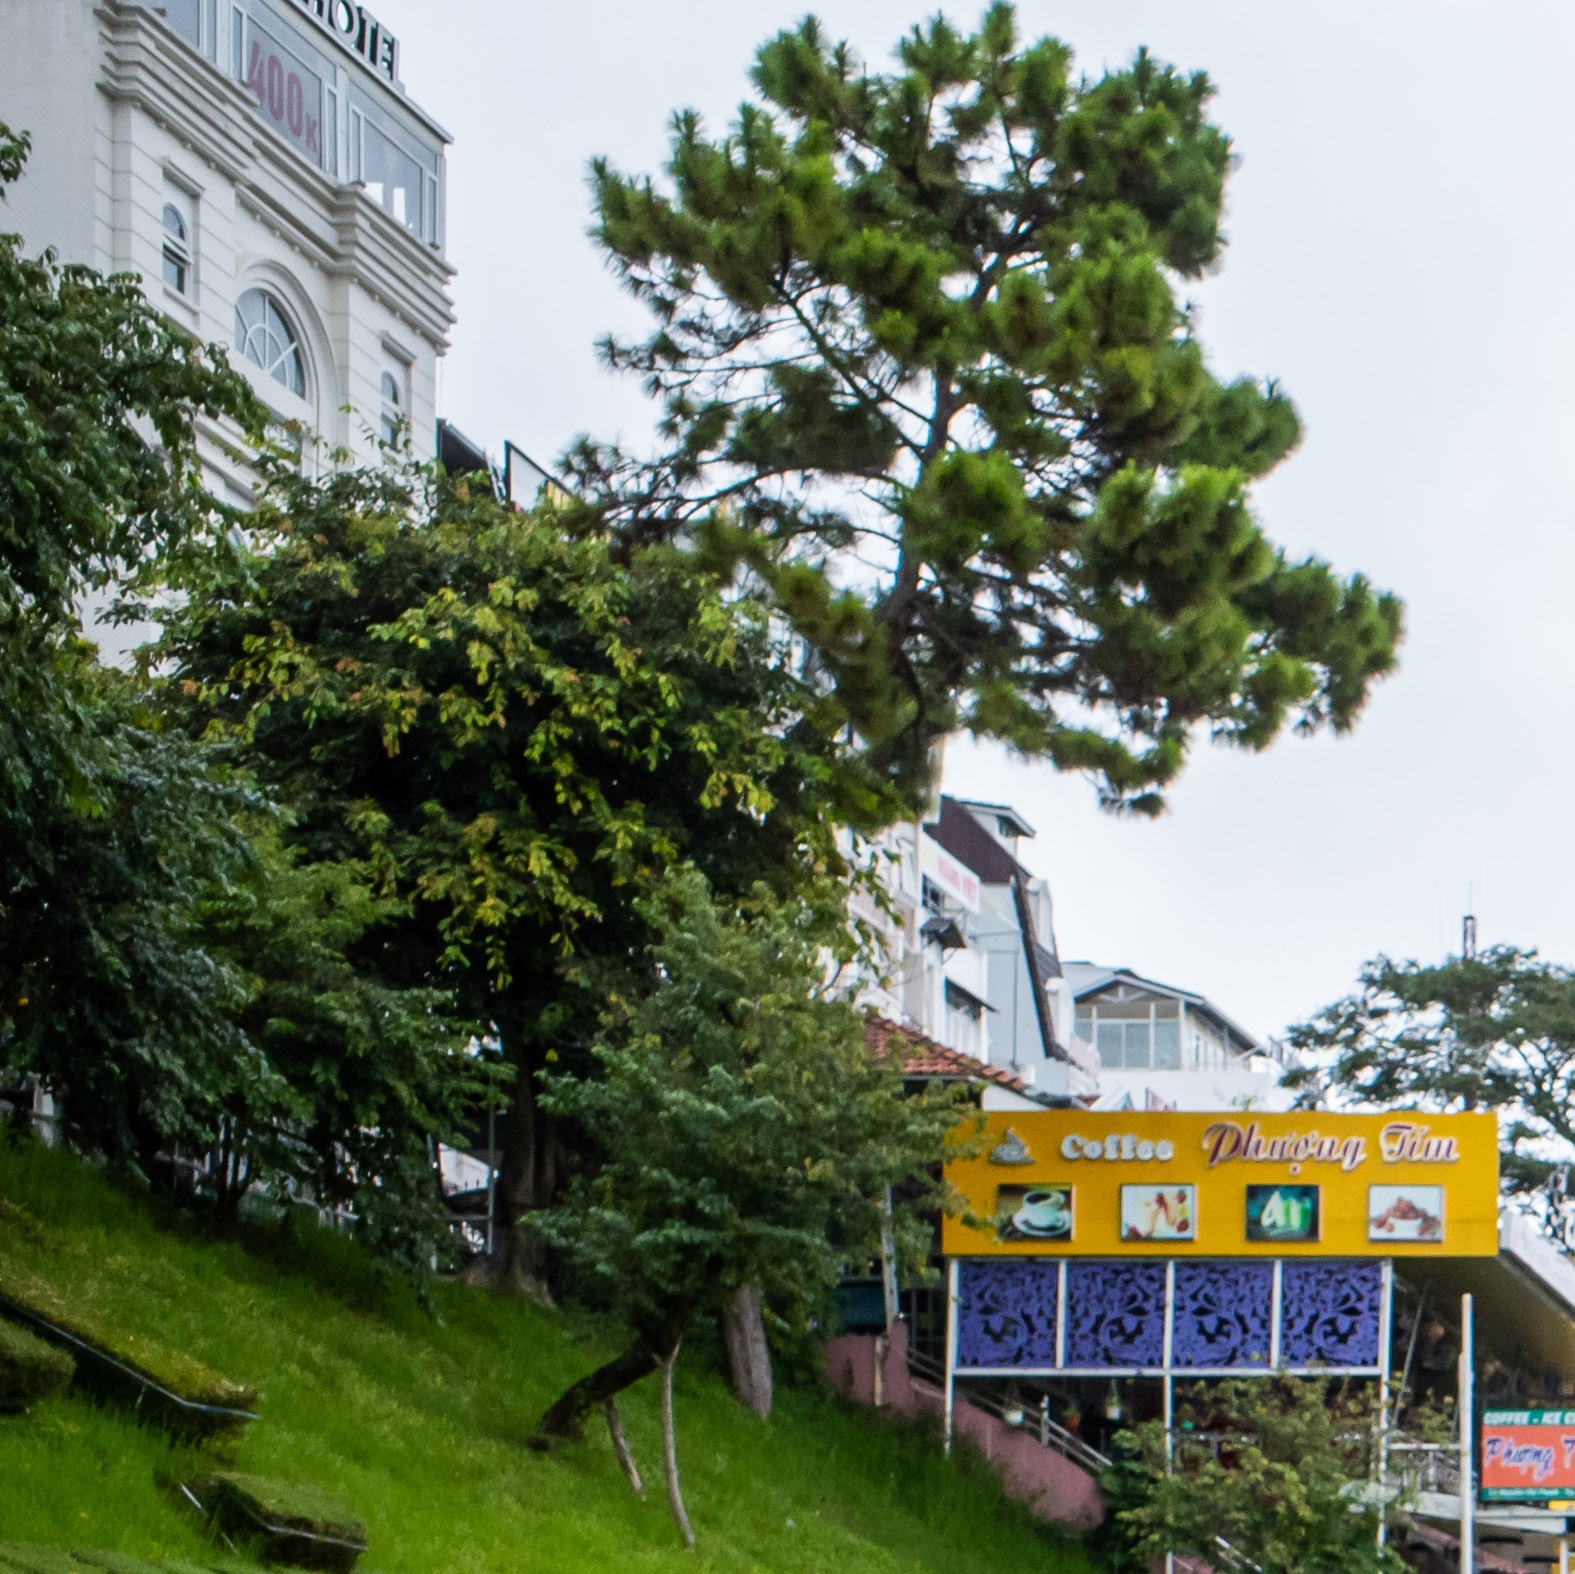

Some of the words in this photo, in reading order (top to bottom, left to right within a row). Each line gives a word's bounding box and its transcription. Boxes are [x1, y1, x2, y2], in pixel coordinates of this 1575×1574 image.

[1061, 1133, 1174, 1162] Coffee
[1203, 1121, 1366, 1176] Phượng
[1379, 1122, 1460, 1163] Tím
